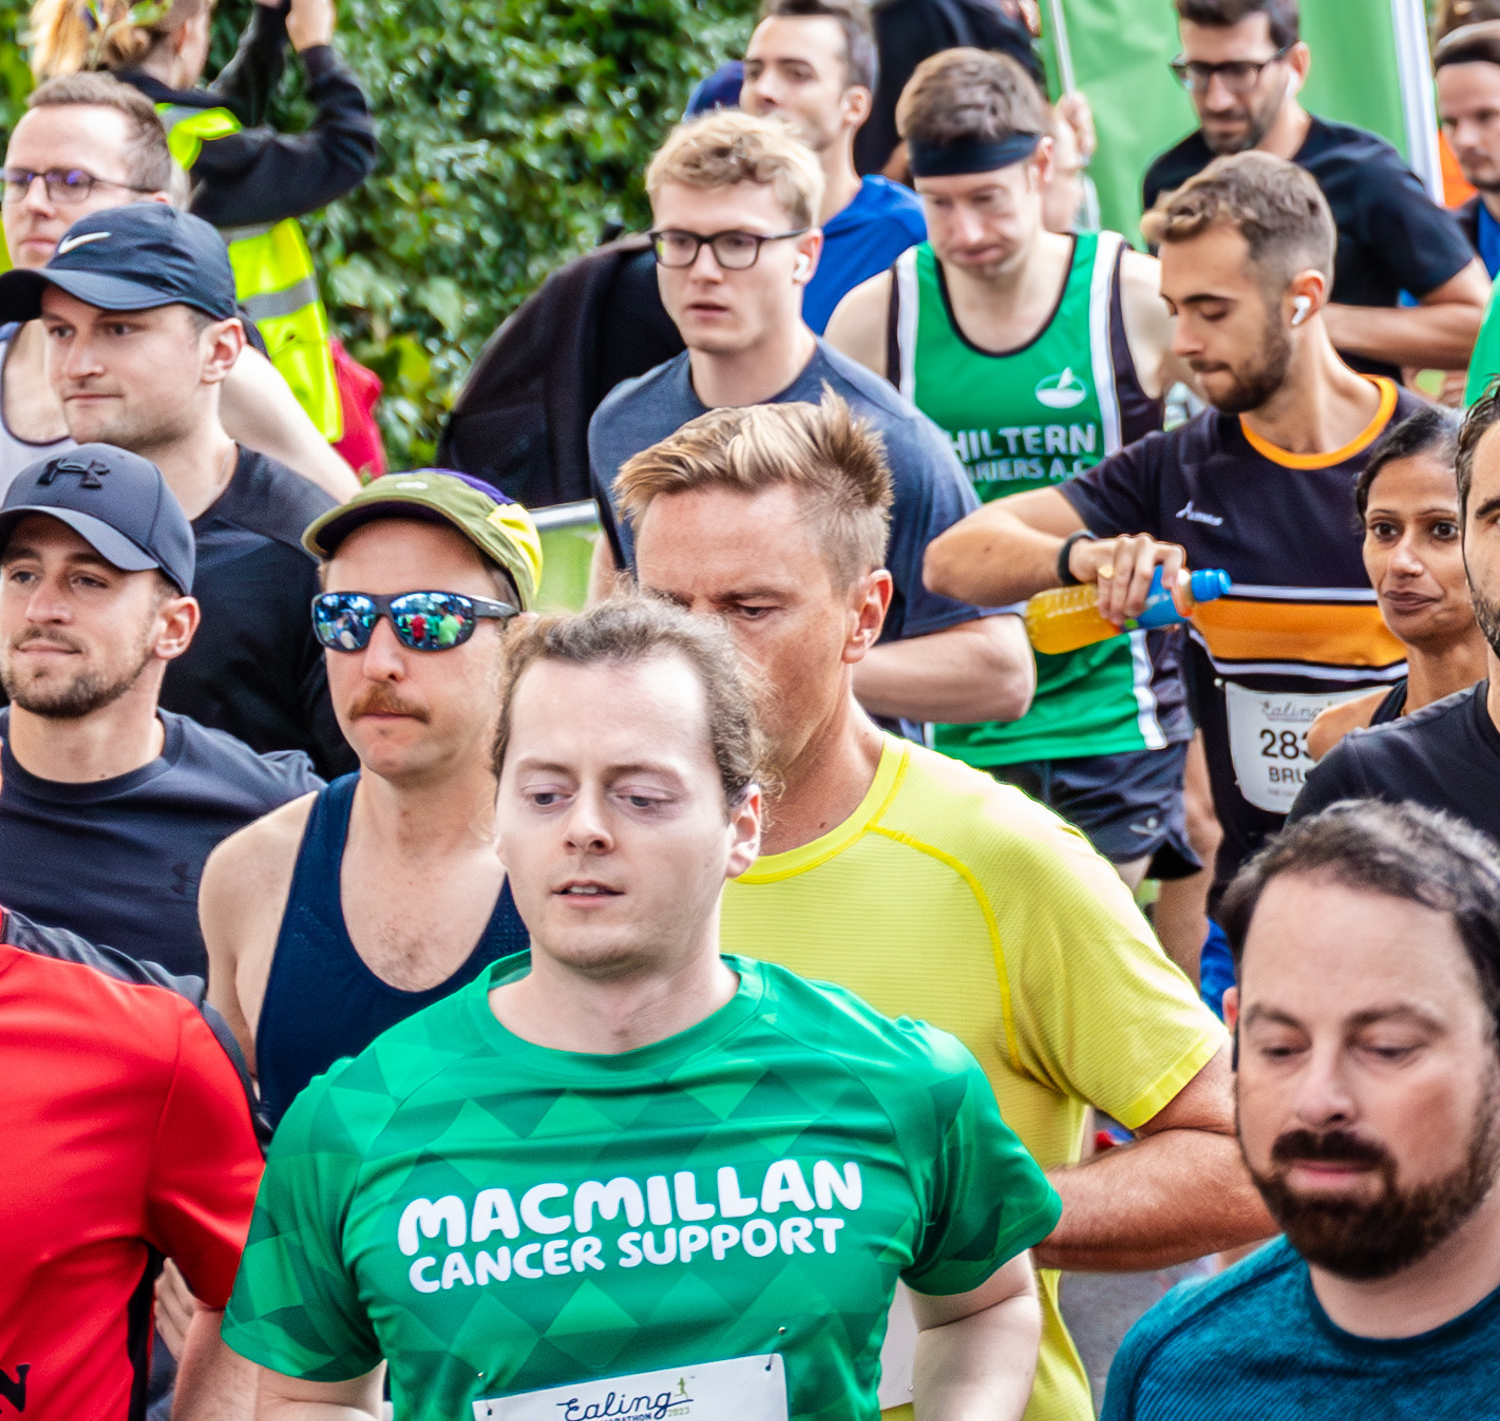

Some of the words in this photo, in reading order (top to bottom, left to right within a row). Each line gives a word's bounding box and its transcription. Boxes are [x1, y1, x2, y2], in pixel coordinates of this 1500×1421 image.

[398, 1159, 863, 1256] MACMILLAN
[408, 1236, 606, 1293] CANCER
[617, 1216, 845, 1268] SUPPORT
[556, 1391, 686, 1421] Ealing
